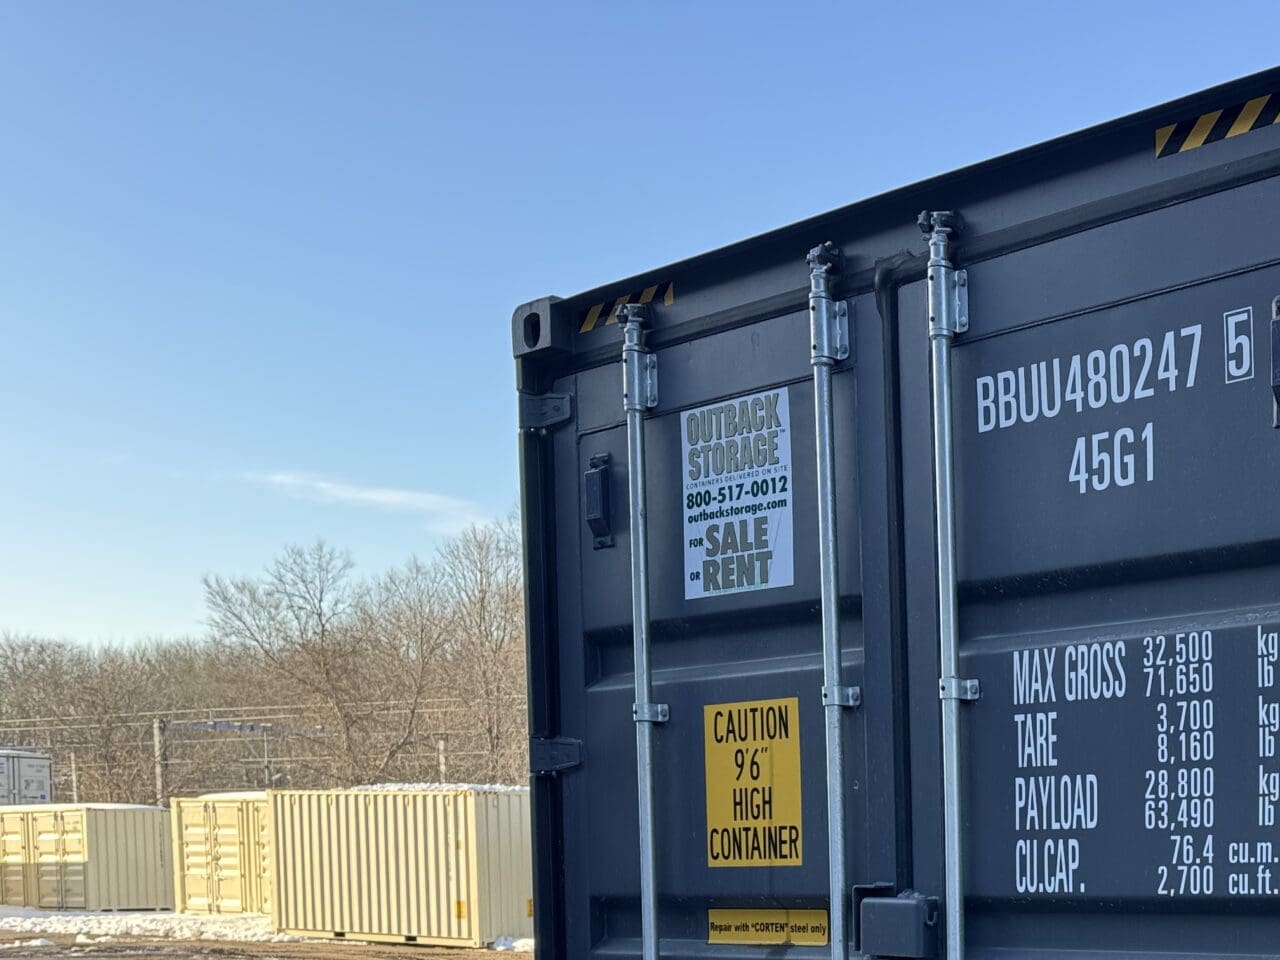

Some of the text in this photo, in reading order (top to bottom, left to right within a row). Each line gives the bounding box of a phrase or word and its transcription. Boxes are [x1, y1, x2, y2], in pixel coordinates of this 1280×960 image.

[976, 312, 1252, 433] BBUU480247 5
[686, 392, 781, 446] OUTBACK
[688, 430, 780, 481] STORAGE
[1068, 422, 1154, 494] 45G1
[686, 464, 788, 490] CONTAINERS DELIVERED ON SITE
[686, 475, 788, 510] 800-517-0012
[688, 498, 787, 524] outbackstorage.com
[689, 516, 769, 557] FOR SALE
[689, 550, 773, 592] OR RENT
[1013, 624, 1279, 705] MAX GROSS 32,500 kg
[1143, 656, 1274, 697] 71,650 lb
[713, 704, 790, 744] CAUTION
[1014, 695, 1280, 768] TARE 3,700 kg
[1157, 726, 1275, 764] 8,160 lb
[733, 786, 773, 822] HIGH
[1015, 764, 1280, 831] PAYLOAD 28,800 kg
[1144, 796, 1275, 831] 63,490 lb
[709, 825, 800, 861] CONTAINER
[1015, 834, 1279, 894] CU.CAP. 76.4 cu.m.
[1157, 865, 1279, 897] 2,700 cu.ft.
[710, 922, 733, 934] Repair
[734, 922, 749, 932] with
[790, 923, 809, 933] steel
[810, 923, 827, 936] only
